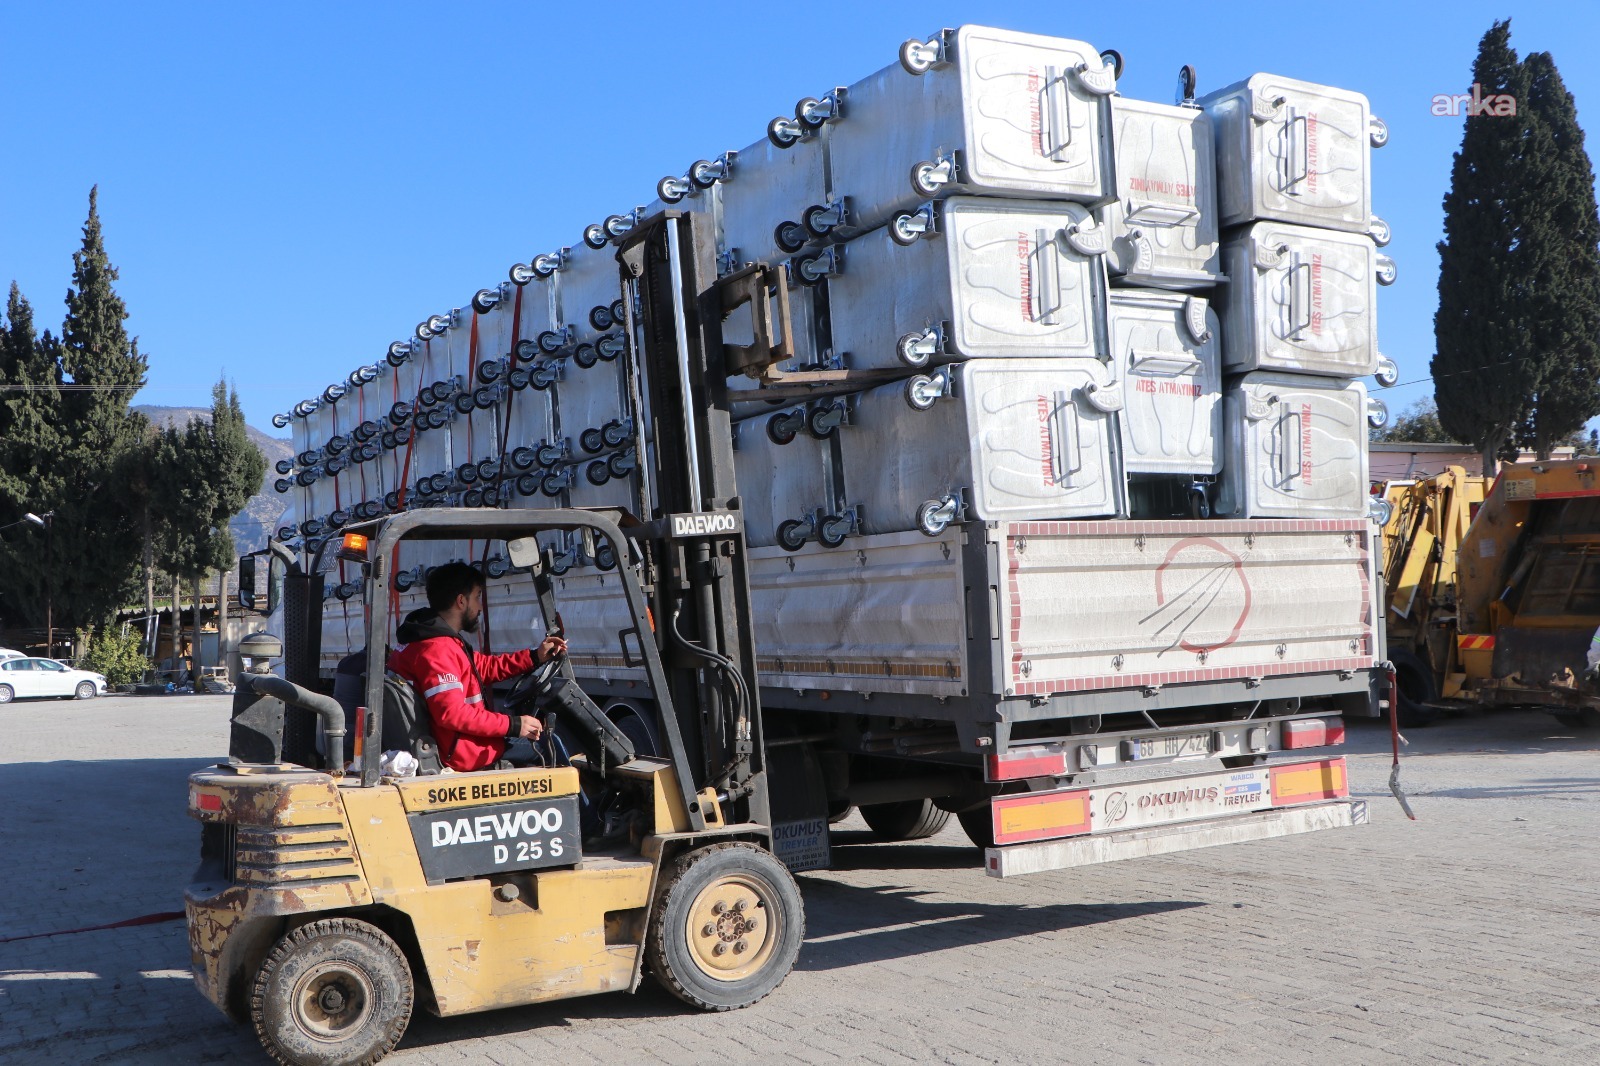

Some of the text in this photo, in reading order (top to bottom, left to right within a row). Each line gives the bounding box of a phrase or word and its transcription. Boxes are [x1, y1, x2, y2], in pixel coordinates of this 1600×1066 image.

[1159, 381, 1202, 397] ATMAYINIZ
[1302, 403, 1312, 457] ATMAYINIZ
[674, 514, 735, 535] DAEWOO
[1140, 740, 1154, 757] 68
[1164, 737, 1179, 755] HH
[471, 775, 553, 800] BELEDİYESİ
[1230, 773, 1255, 782] WABCO
[1136, 787, 1219, 808] OKUMUŞ
[1223, 792, 1261, 806] TREYLER
[431, 807, 563, 848] DAEWOO
[774, 821, 823, 840] OKUMUŞ
[493, 837, 564, 865] D 25 S
[781, 837, 818, 850] TREYLER
